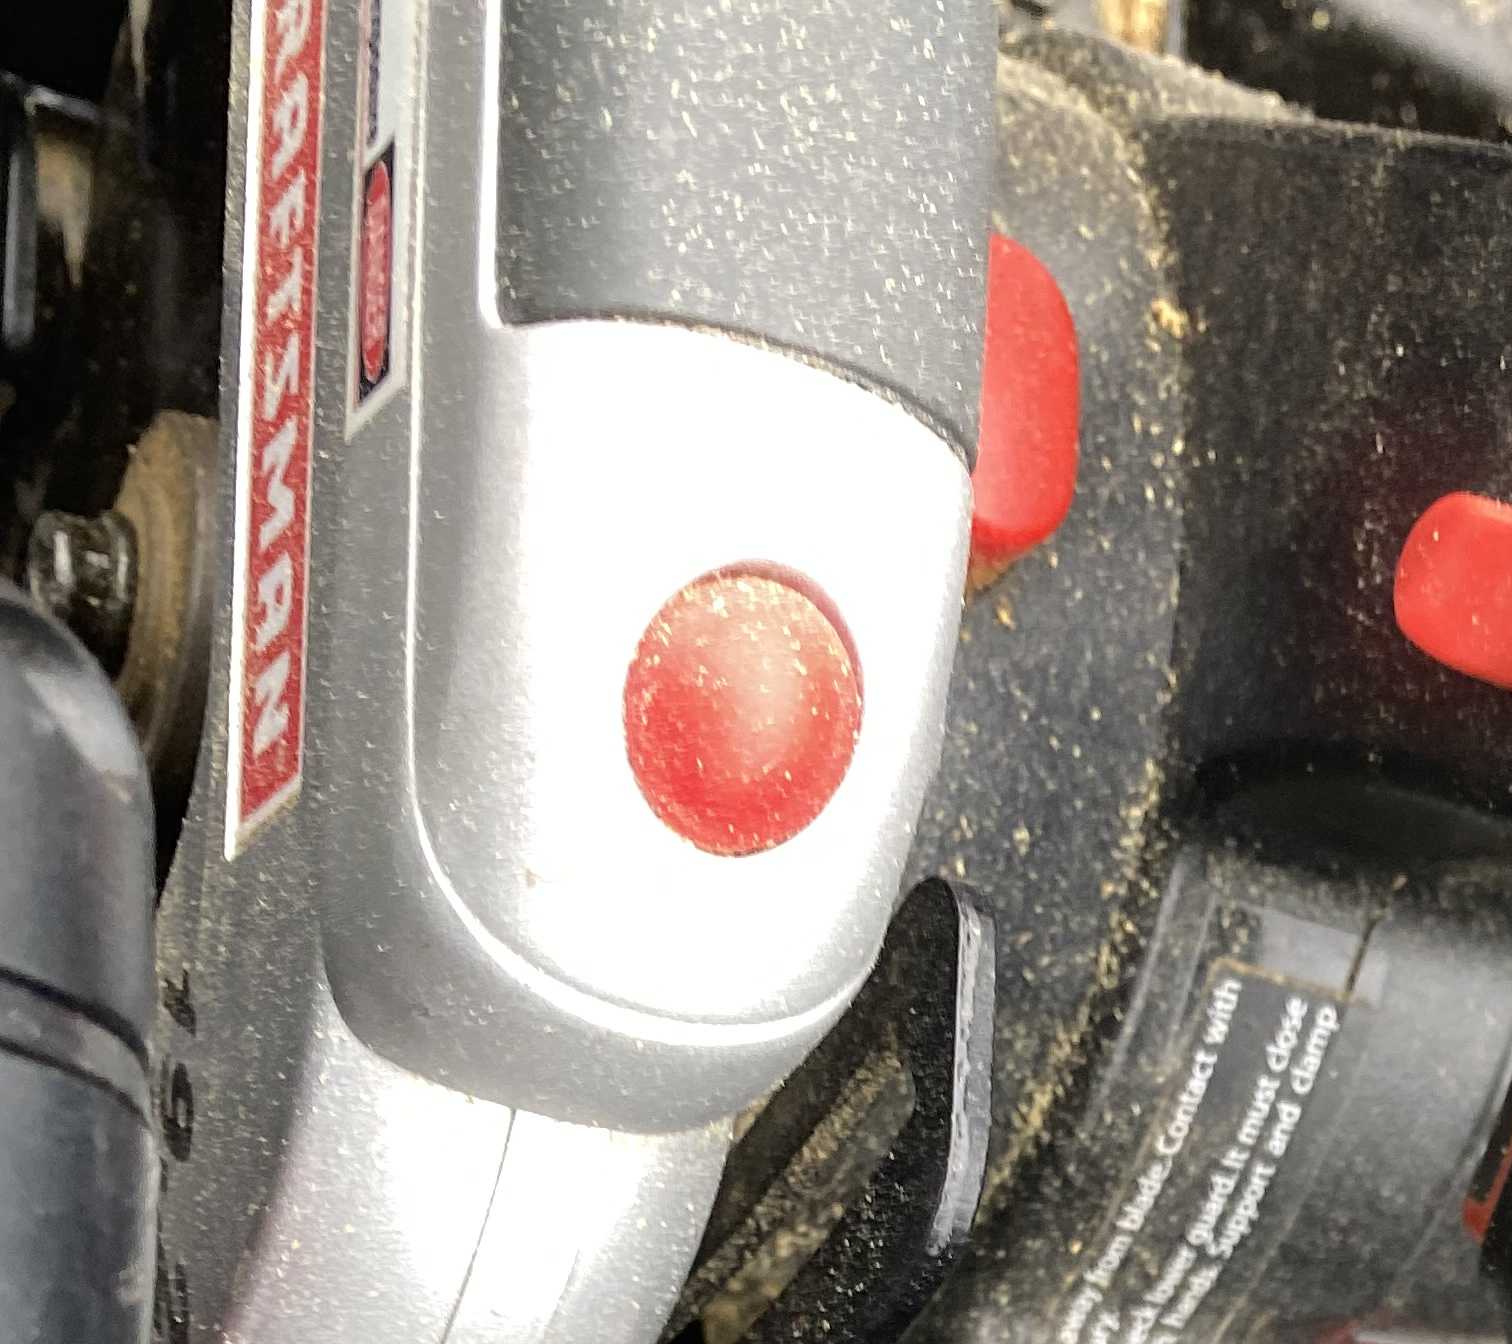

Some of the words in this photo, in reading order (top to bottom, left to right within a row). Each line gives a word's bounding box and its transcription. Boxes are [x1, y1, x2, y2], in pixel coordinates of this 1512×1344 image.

[254, 0, 311, 753] RAFTSMAN
[1084, 1233, 1133, 1285] from
[1155, 1048, 1218, 1155] Contact
[1202, 977, 1243, 1044] with
[1144, 1244, 1195, 1304] lower
[1236, 1073, 1281, 1144] must
[1263, 996, 1309, 1072] close
[1206, 1159, 1276, 1257] Support
[1266, 1102, 1303, 1156] and
[1290, 1006, 1339, 1094] clamp
